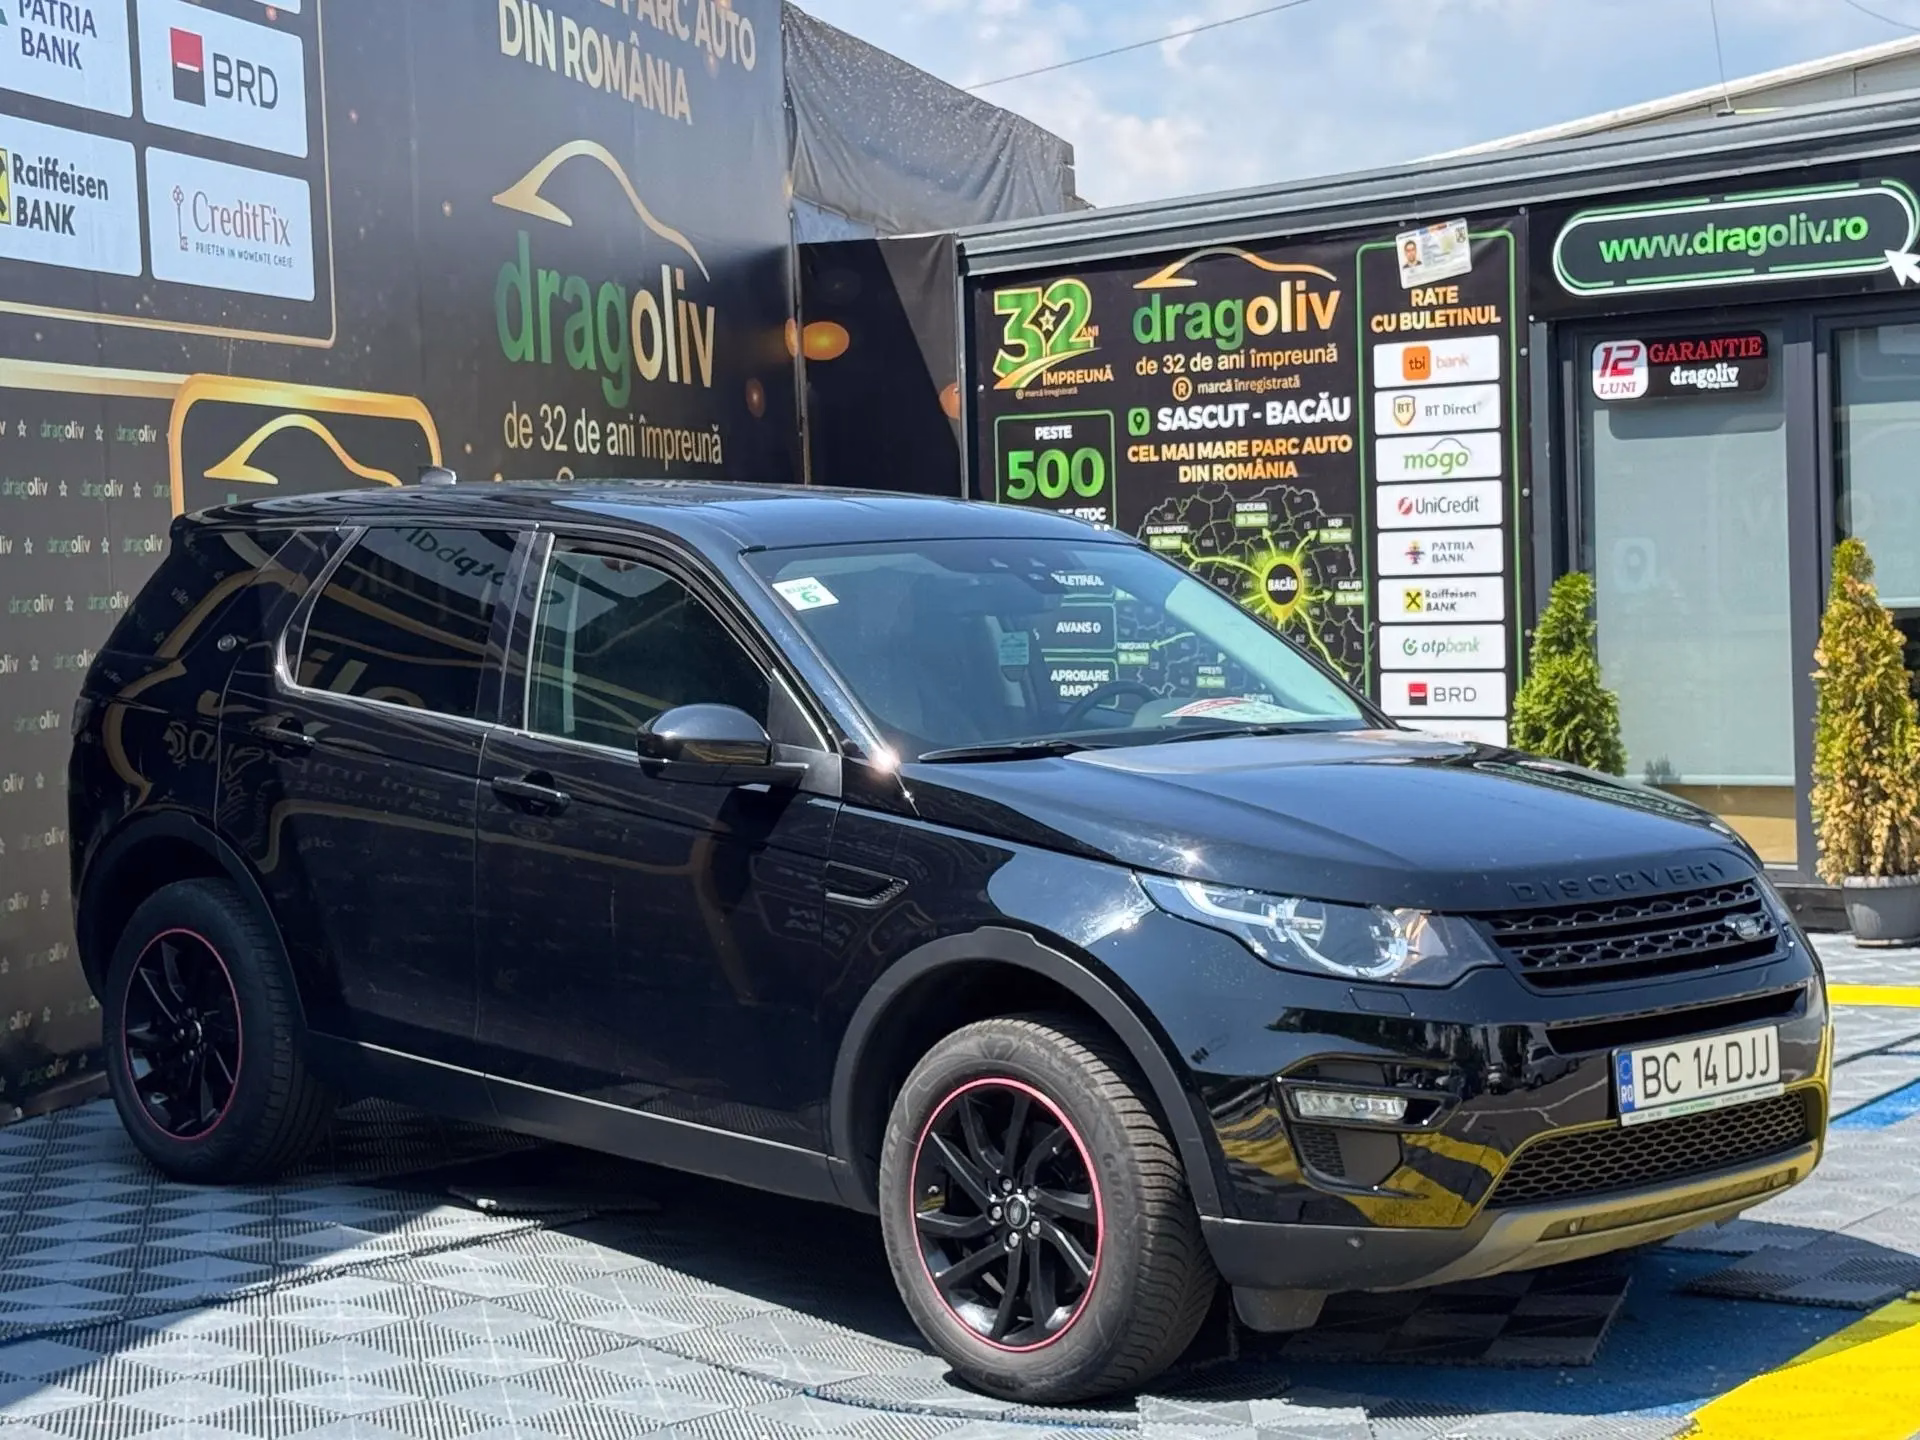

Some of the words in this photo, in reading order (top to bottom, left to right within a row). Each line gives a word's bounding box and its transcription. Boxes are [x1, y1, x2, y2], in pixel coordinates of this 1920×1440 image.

[19, 0, 97, 38] PATRIA
[621, 0, 690, 41] ARC
[694, 0, 756, 71] AUTO
[21, 27, 83, 70] BANK
[499, 0, 556, 72] DIN
[561, 16, 693, 125] ROMÂNIA
[212, 52, 278, 109] BRD
[13, 152, 109, 200] Raiffeisen
[16, 196, 76, 236] BANK
[192, 190, 291, 247] CreditFix
[1599, 212, 1869, 263] www.dragoliv.ro
[1411, 286, 1459, 307] RATE
[494, 230, 716, 408] dragoliv
[1132, 280, 1341, 350] dragoliv
[1371, 314, 1397, 333] CU
[1400, 305, 1501, 331] BULETINUL
[993, 278, 1092, 378] 32
[1080, 325, 1099, 337] ANI
[1135, 356, 1158, 376] de
[1163, 353, 1185, 374] 32
[1189, 352, 1214, 373] de
[1217, 350, 1245, 371] ani
[1250, 343, 1338, 371] împreună
[1436, 353, 1469, 369] bank
[1599, 344, 1641, 378] 12
[1649, 336, 1762, 363] GARANTIE
[1042, 364, 1114, 386] ÎMPREUNĂ
[1408, 356, 1425, 370] tbi
[1670, 362, 1739, 389] dragoliv
[1197, 379, 1233, 394] marcă
[1234, 374, 1300, 395] înregistrată
[1599, 381, 1637, 395] LUNI
[1157, 403, 1249, 431] SASCUT
[1266, 391, 1351, 426] BACĂU
[1397, 402, 1411, 414] BT
[1425, 405, 1440, 416] BT
[1443, 403, 1476, 415] Direct
[40, 419, 85, 442] dragoliv
[116, 424, 157, 446] dragoliv
[504, 401, 534, 449] de
[540, 403, 568, 451] 32
[574, 408, 600, 455] de
[606, 413, 635, 457] ani
[639, 414, 723, 471] împreună
[1035, 425, 1073, 440] PESTE
[1127, 444, 1160, 463] CEL
[1162, 443, 1195, 461] MAI
[1198, 440, 1249, 460] MARE
[1252, 438, 1300, 457] PARC
[1302, 435, 1353, 454] AUTO
[1006, 447, 1106, 500] 500
[1179, 464, 1210, 483] DIN
[1213, 458, 1299, 481] ROMÂNIA
[1404, 452, 1469, 475] mogo
[3, 477, 48, 499] dragoliv
[80, 479, 124, 501] dragoliv
[1415, 496, 1479, 515] UniCredit
[48, 535, 91, 557] dragoliv
[123, 534, 163, 557] dragoliv
[1432, 541, 1474, 551] PATRIA
[1432, 553, 1465, 563] BANK
[9, 594, 54, 617] dragoliv
[801, 591, 821, 603] 6
[1425, 589, 1476, 600] Raiffeisen
[1426, 602, 1457, 612] BANK
[1056, 622, 1092, 633] AVANS
[1421, 636, 1480, 658] otpbank
[1050, 669, 1110, 682] APROBARE
[1433, 686, 1477, 703] BRD
[1507, 861, 1726, 902] DISCOVERY
[1642, 1051, 1682, 1099] BC
[1693, 1044, 1718, 1089] 14
[1726, 1034, 1770, 1084] DJJ
[1621, 1084, 1633, 1103] RO
